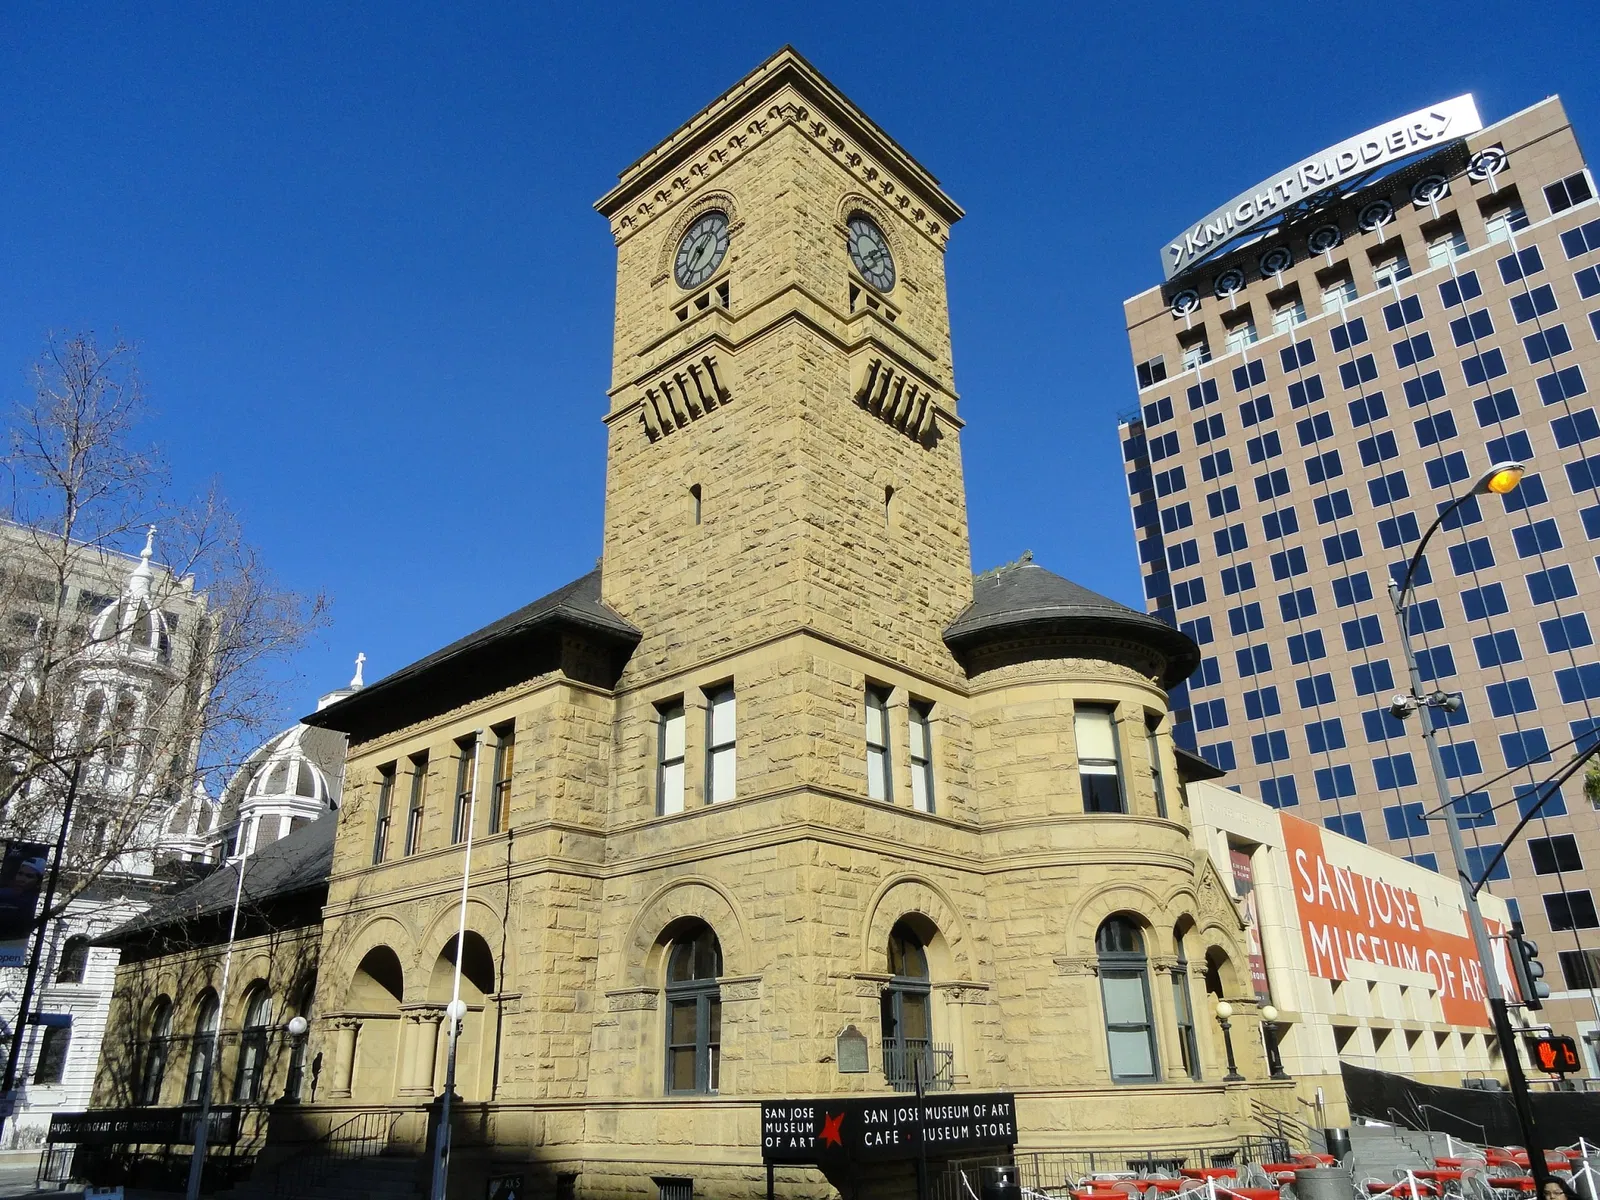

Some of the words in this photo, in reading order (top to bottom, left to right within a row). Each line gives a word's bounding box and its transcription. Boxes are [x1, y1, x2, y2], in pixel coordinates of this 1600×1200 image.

[1295, 848, 1360, 915] SAN
[1361, 875, 1420, 932] JOSE
[1425, 949, 1455, 999] OF
[1459, 956, 1486, 1002] AR
[765, 1108, 786, 1119] SAN
[790, 1107, 814, 1121] JOSE
[863, 1109, 888, 1124] SAN
[893, 1107, 919, 1126] JOSE
[925, 1105, 969, 1120] MUSEUM
[973, 1104, 987, 1117] OF
[991, 1103, 1010, 1117] ART
[100, 1122, 111, 1132] ART
[765, 1122, 814, 1133] MUSEUM
[864, 1130, 899, 1146] CAFE
[975, 1122, 1011, 1137] STORE
[765, 1137, 782, 1148] OF
[789, 1137, 815, 1148] ART
